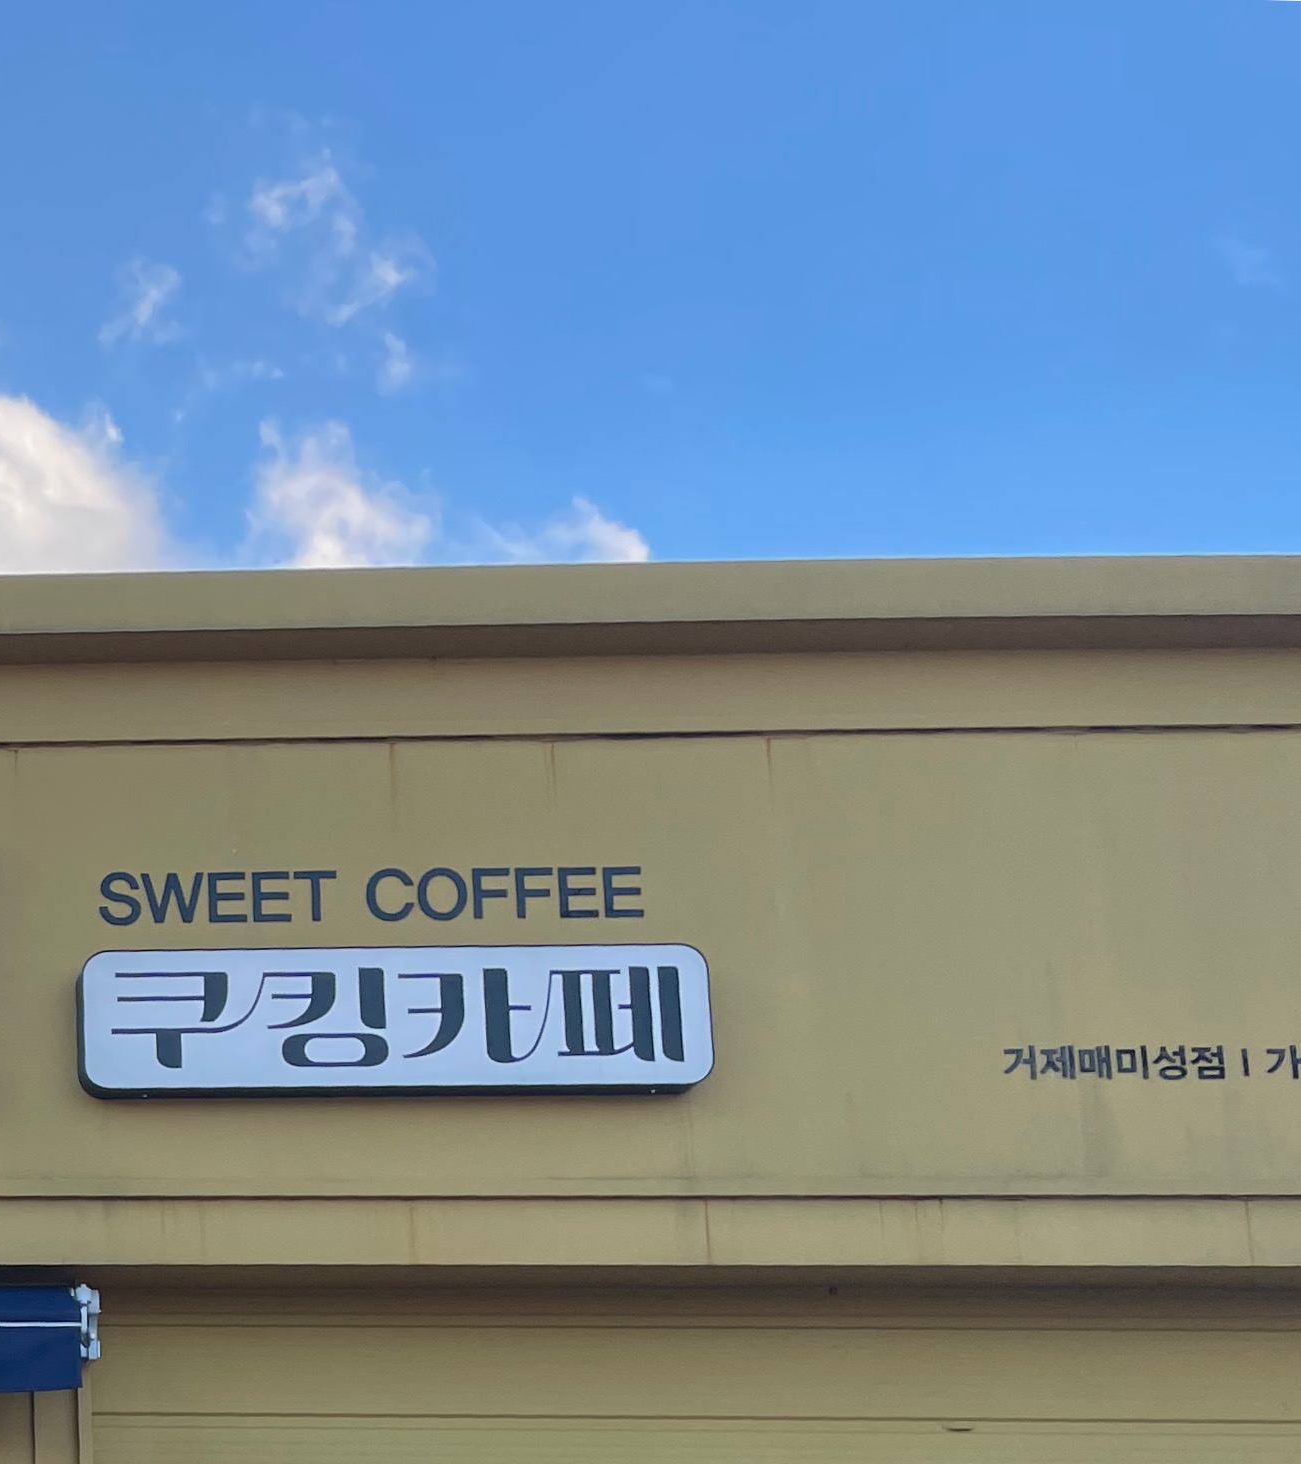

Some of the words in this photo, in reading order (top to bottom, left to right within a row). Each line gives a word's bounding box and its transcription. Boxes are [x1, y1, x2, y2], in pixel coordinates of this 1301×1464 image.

[98, 869, 337, 926] SWEET
[366, 865, 646, 922] COFFEE
[110, 965, 686, 1069] 쿠킹카페
[1003, 1044, 1226, 1081] 거제매미성점
